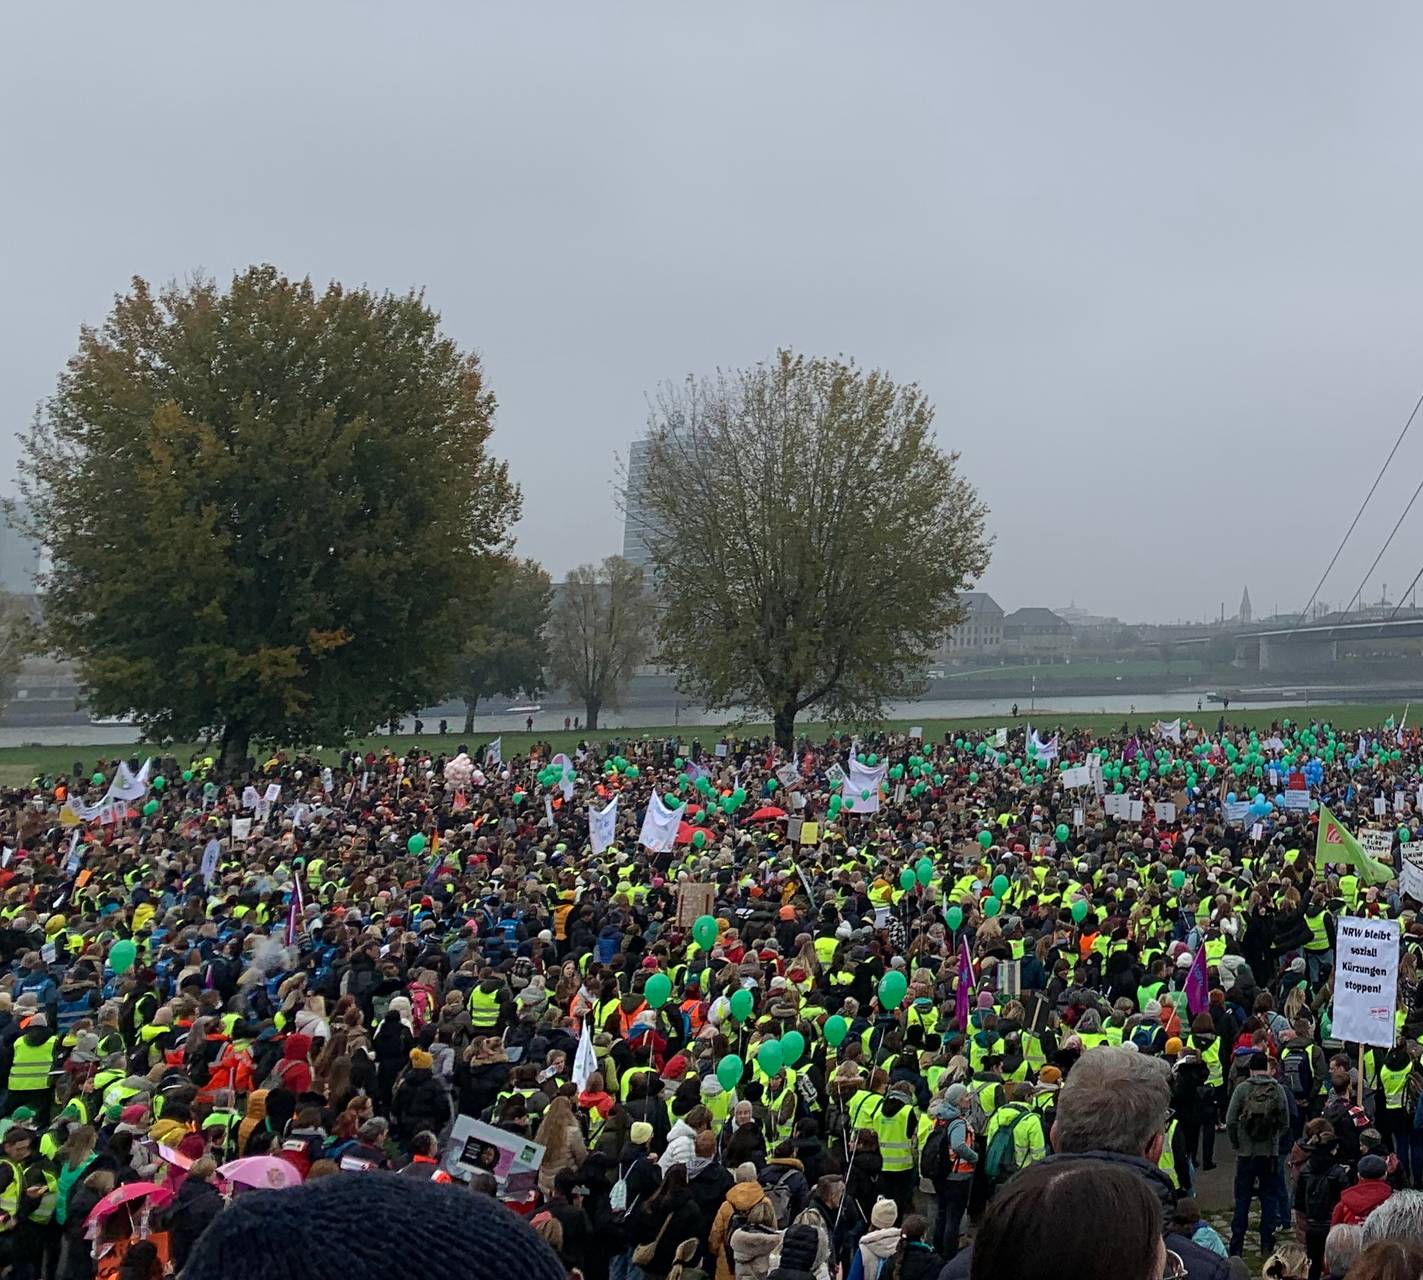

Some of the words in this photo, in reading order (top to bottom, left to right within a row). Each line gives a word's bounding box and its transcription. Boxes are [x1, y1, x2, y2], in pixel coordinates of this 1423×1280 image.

[1342, 926, 1362, 936] NRW
[1364, 929, 1392, 940] bleibt
[1350, 946, 1378, 958] sozial!
[1342, 962, 1387, 977] Kürzungen
[1345, 980, 1382, 994] stoppen!
